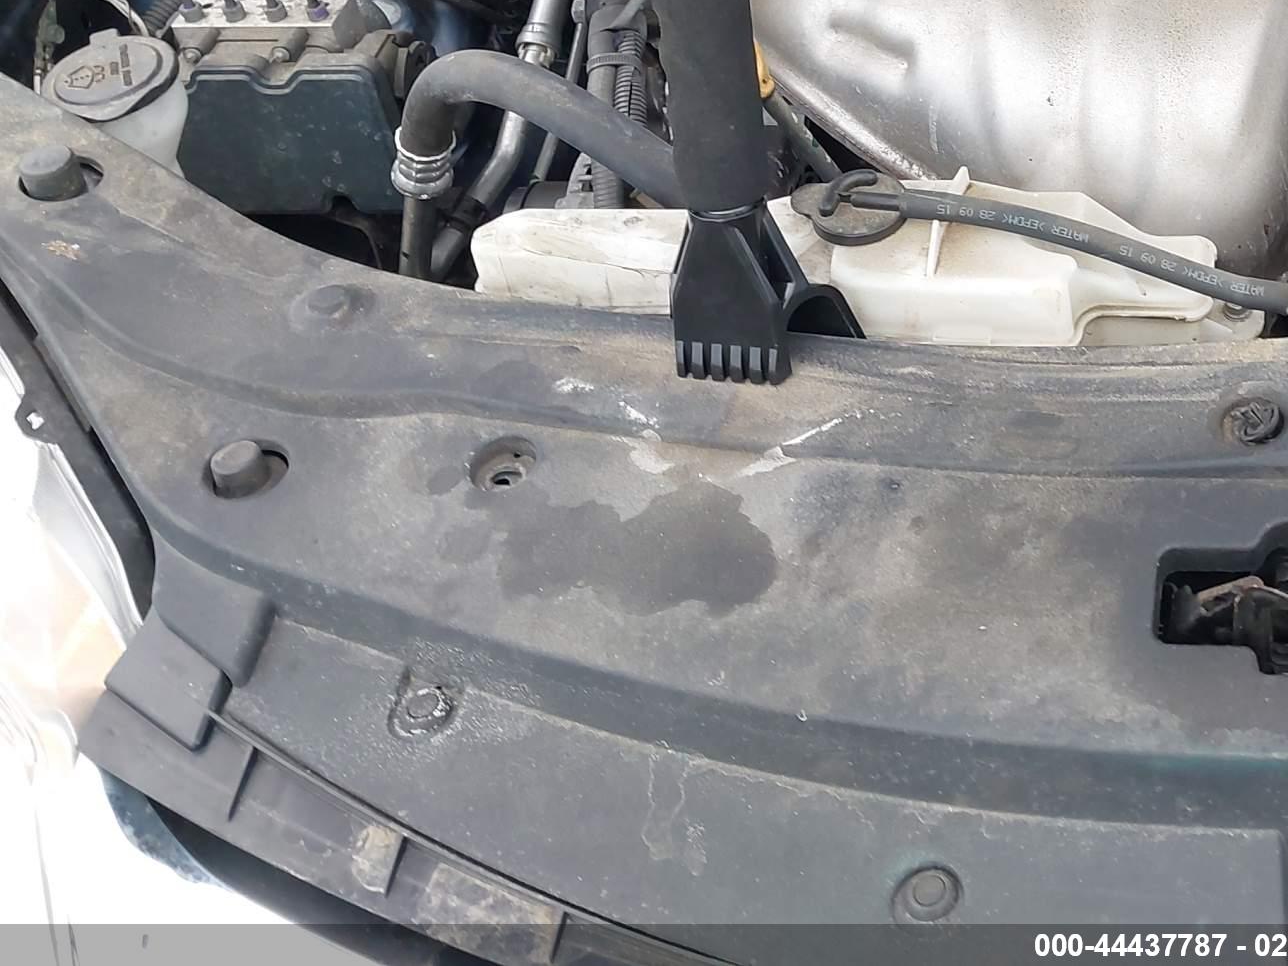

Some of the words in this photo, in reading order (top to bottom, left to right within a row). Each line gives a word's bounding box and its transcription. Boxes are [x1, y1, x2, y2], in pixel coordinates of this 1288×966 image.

[936, 204, 951, 215] 15
[959, 207, 974, 217] 09
[979, 209, 997, 221] 28
[1051, 225, 1089, 243] WATER
[1119, 245, 1133, 258] 15
[1140, 252, 1156, 264] 09
[1160, 258, 1177, 271] 28
[1230, 281, 1265, 297] WATER
